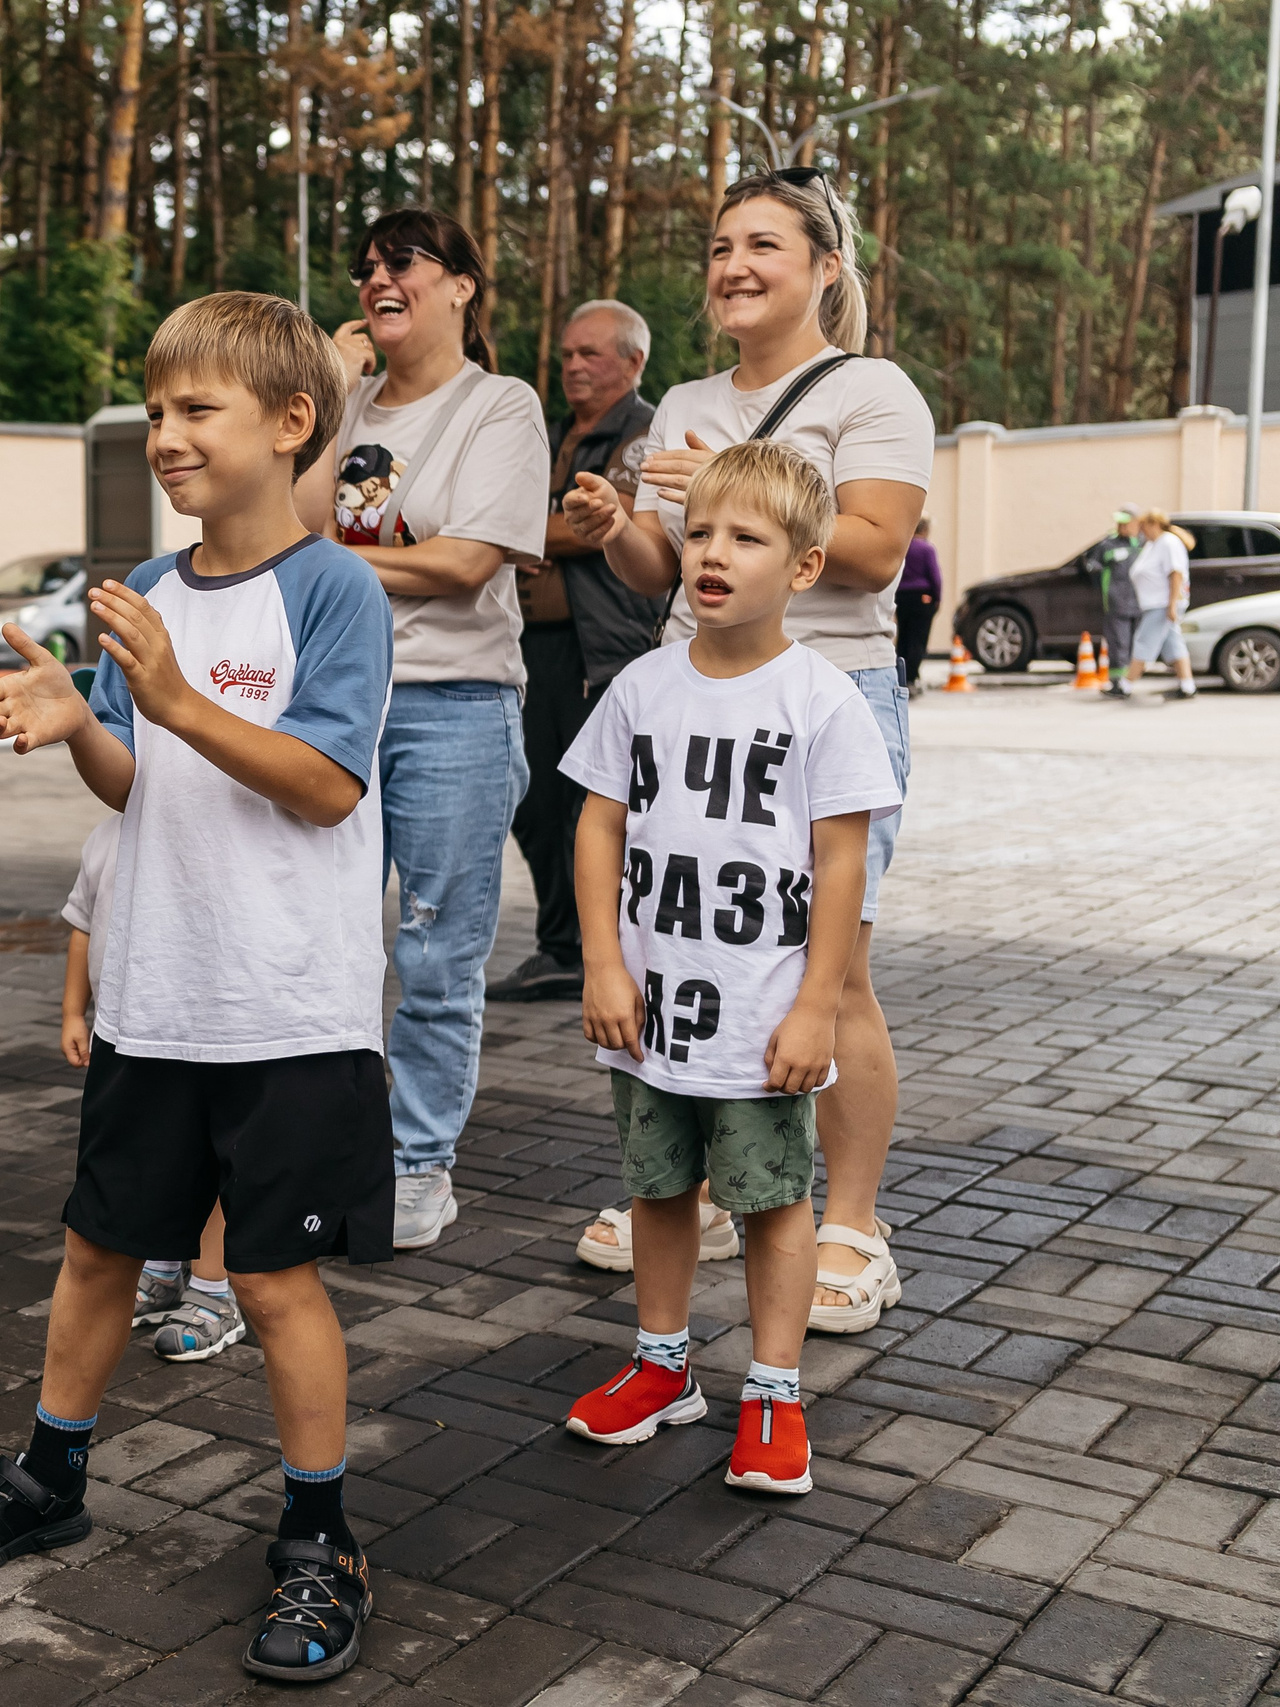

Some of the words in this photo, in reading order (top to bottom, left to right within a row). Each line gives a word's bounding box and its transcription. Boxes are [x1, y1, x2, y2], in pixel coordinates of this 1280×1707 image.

[210, 660, 276, 688] Oakland
[240, 686, 269, 701] 1992
[629, 734, 659, 813] А
[685, 728, 794, 827] ЧЁ
[619, 847, 811, 946] РАЗУ
